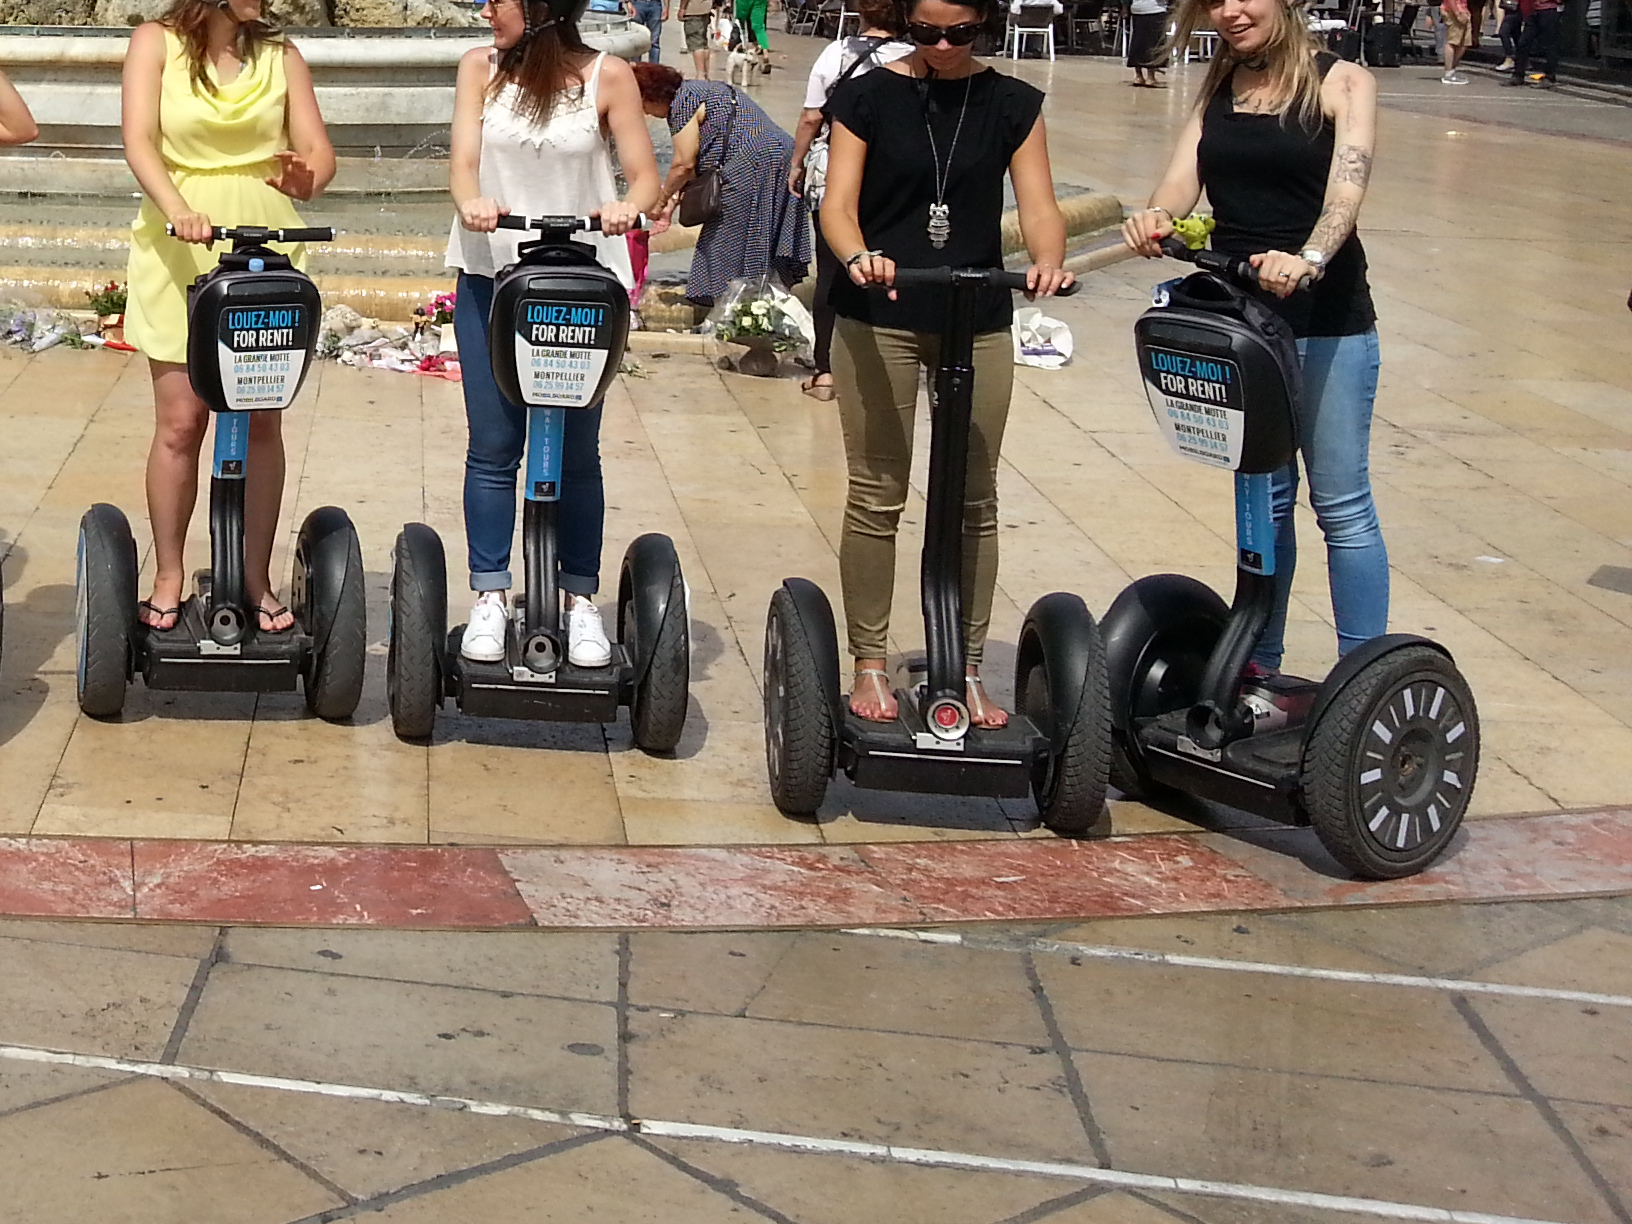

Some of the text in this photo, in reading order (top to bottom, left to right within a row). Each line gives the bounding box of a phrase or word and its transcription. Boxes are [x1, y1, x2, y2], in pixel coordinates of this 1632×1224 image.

[228, 309, 293, 330] LOUEZ-MOI
[526, 305, 596, 325] LOUEZ-MOI
[232, 328, 293, 348] FOR RENT!
[530, 324, 596, 345] FOR RENT!
[233, 353, 290, 364] LA GRANDE MOTTE
[531, 348, 592, 361] LA GRANDE MOTTE
[533, 370, 586, 381] MONTPELLIER
[1151, 352, 1222, 382] LOUEZ-MOI
[237, 374, 285, 385] MONTPELLIER
[1160, 372, 1227, 403] FOR RENT!
[1166, 398, 1228, 420] LA GRANDE MOTTE
[1174, 421, 1228, 442] MONTPELLIER
